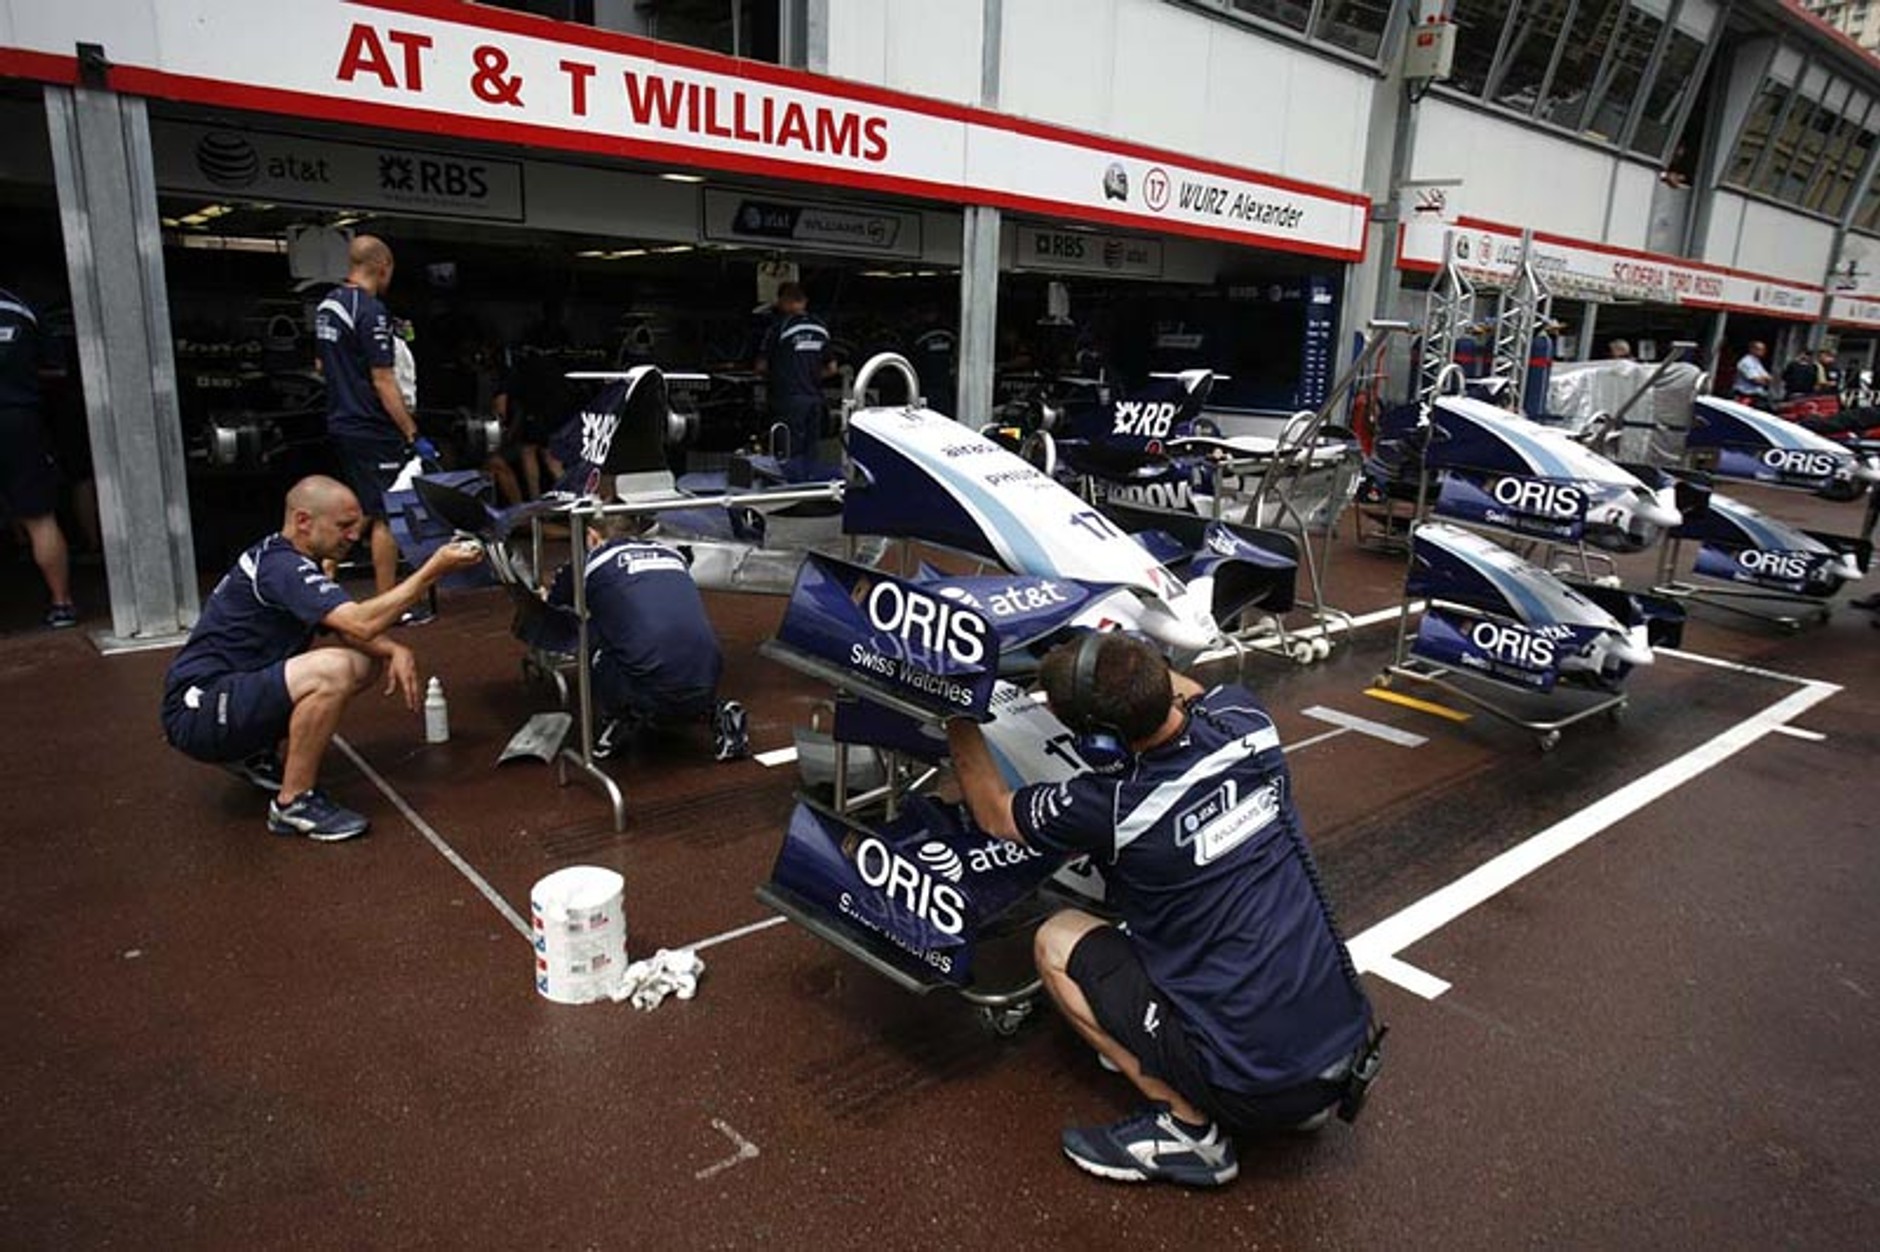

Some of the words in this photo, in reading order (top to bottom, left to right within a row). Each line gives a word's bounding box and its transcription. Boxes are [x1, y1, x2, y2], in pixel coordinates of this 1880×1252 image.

[337, 23, 432, 91] AT
[470, 45, 525, 107] &
[560, 60, 596, 116] T
[624, 71, 888, 162] WILLIAMS
[268, 155, 330, 183] at&t
[420, 160, 488, 198] RBS
[1150, 179, 1165, 201] 17
[1179, 181, 1229, 215] WURZ
[1229, 192, 1304, 228] Alexander
[1053, 235, 1085, 258] RBS
[1134, 402, 1182, 438] RB
[1764, 449, 1835, 476] ORIS
[1495, 477, 1581, 515] ORIS
[1070, 511, 1118, 541] 17
[1739, 550, 1808, 577] ORIS
[989, 579, 1067, 616] at&t
[869, 581, 987, 664] ORIS
[1473, 622, 1554, 666] ORIS
[851, 643, 895, 677] Swiss
[899, 664, 974, 706] Watches
[857, 838, 965, 935] ORIS
